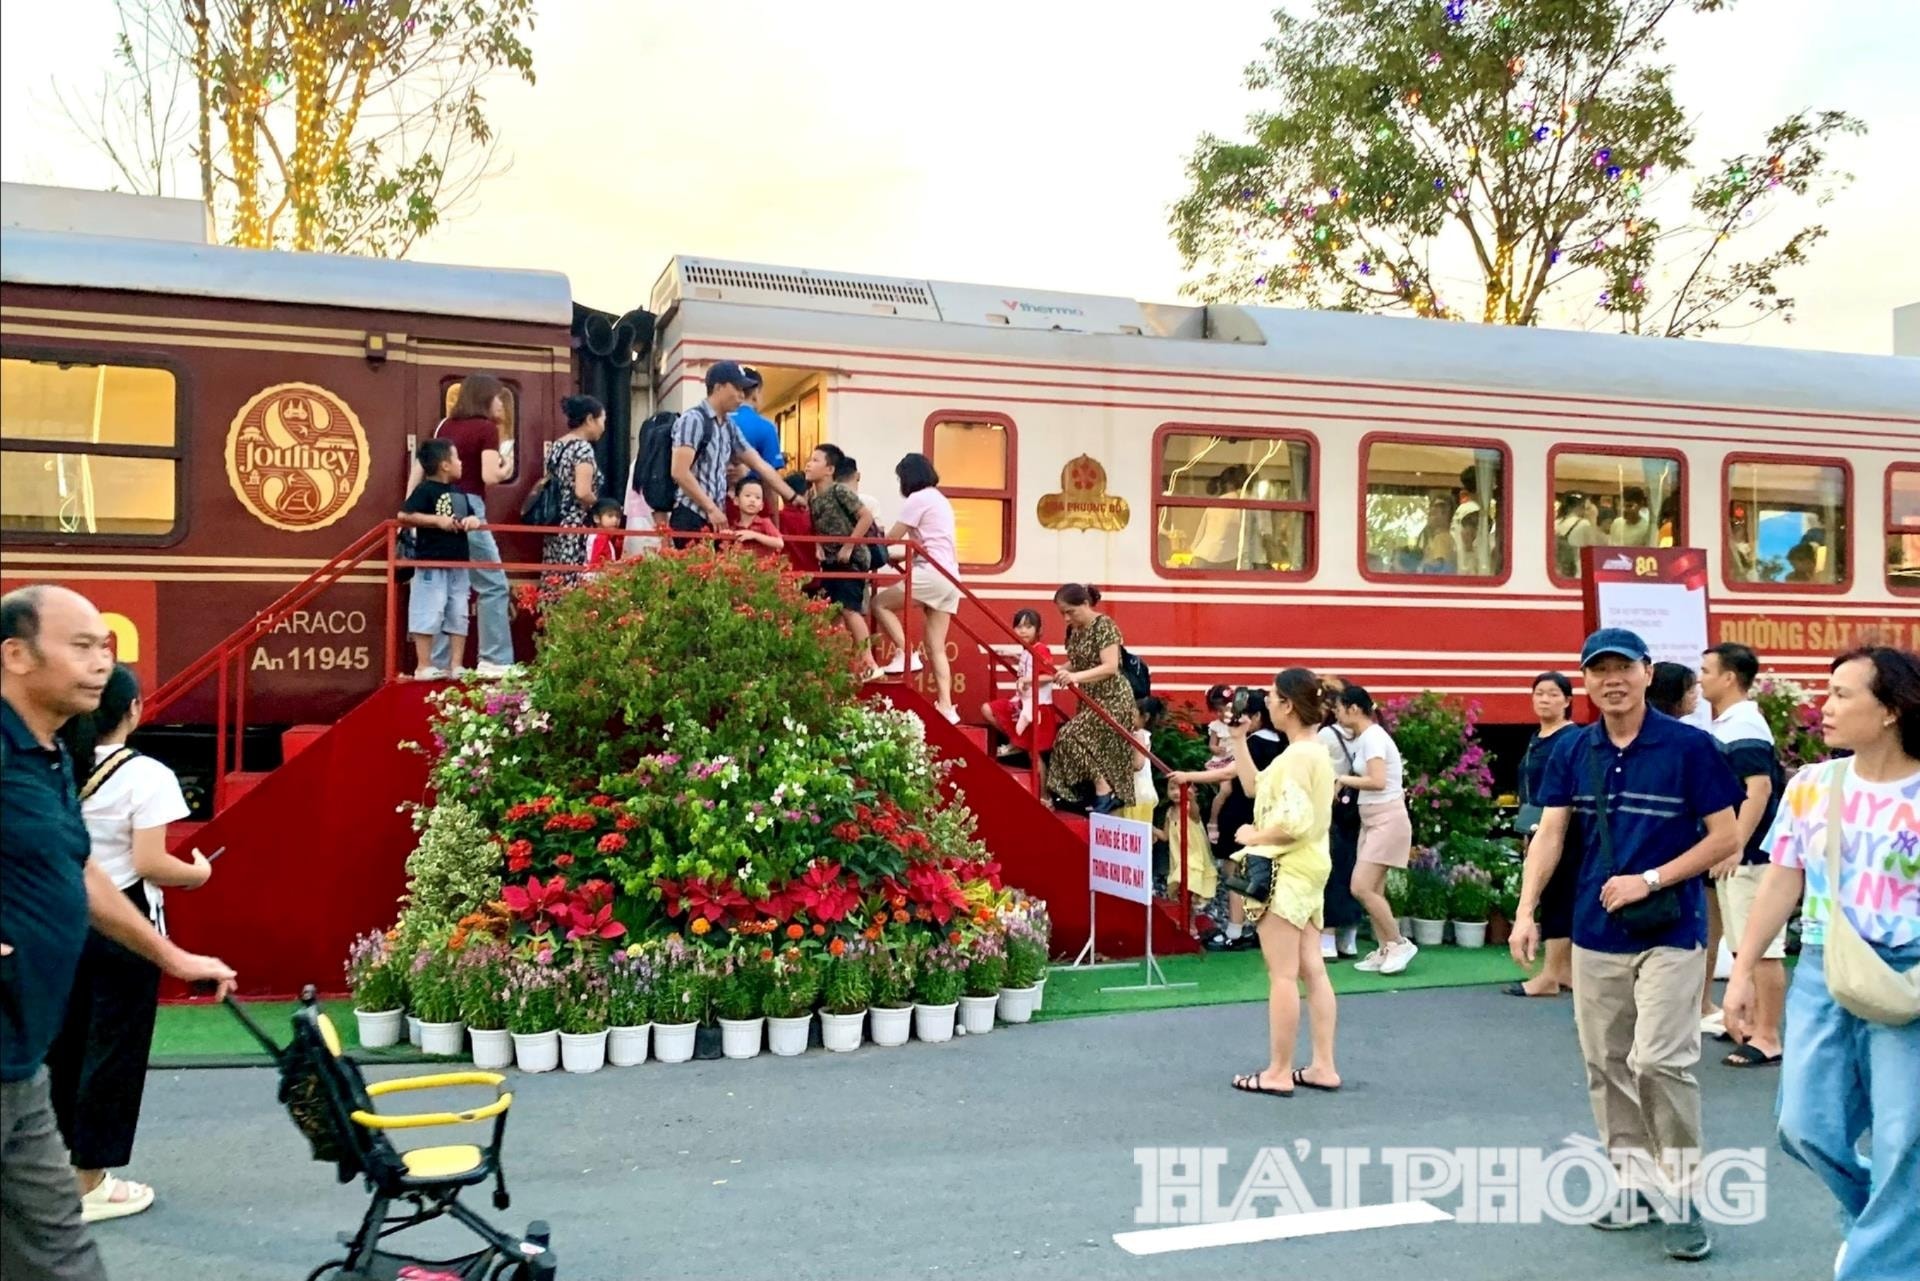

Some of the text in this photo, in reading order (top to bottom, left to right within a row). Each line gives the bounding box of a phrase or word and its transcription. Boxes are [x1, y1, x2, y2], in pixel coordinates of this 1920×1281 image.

[239, 442, 355, 475] Journey
[1719, 613, 1804, 650] ĐƯỜNG
[1807, 614, 1851, 650] SẮT
[251, 647, 369, 671] An 11945
